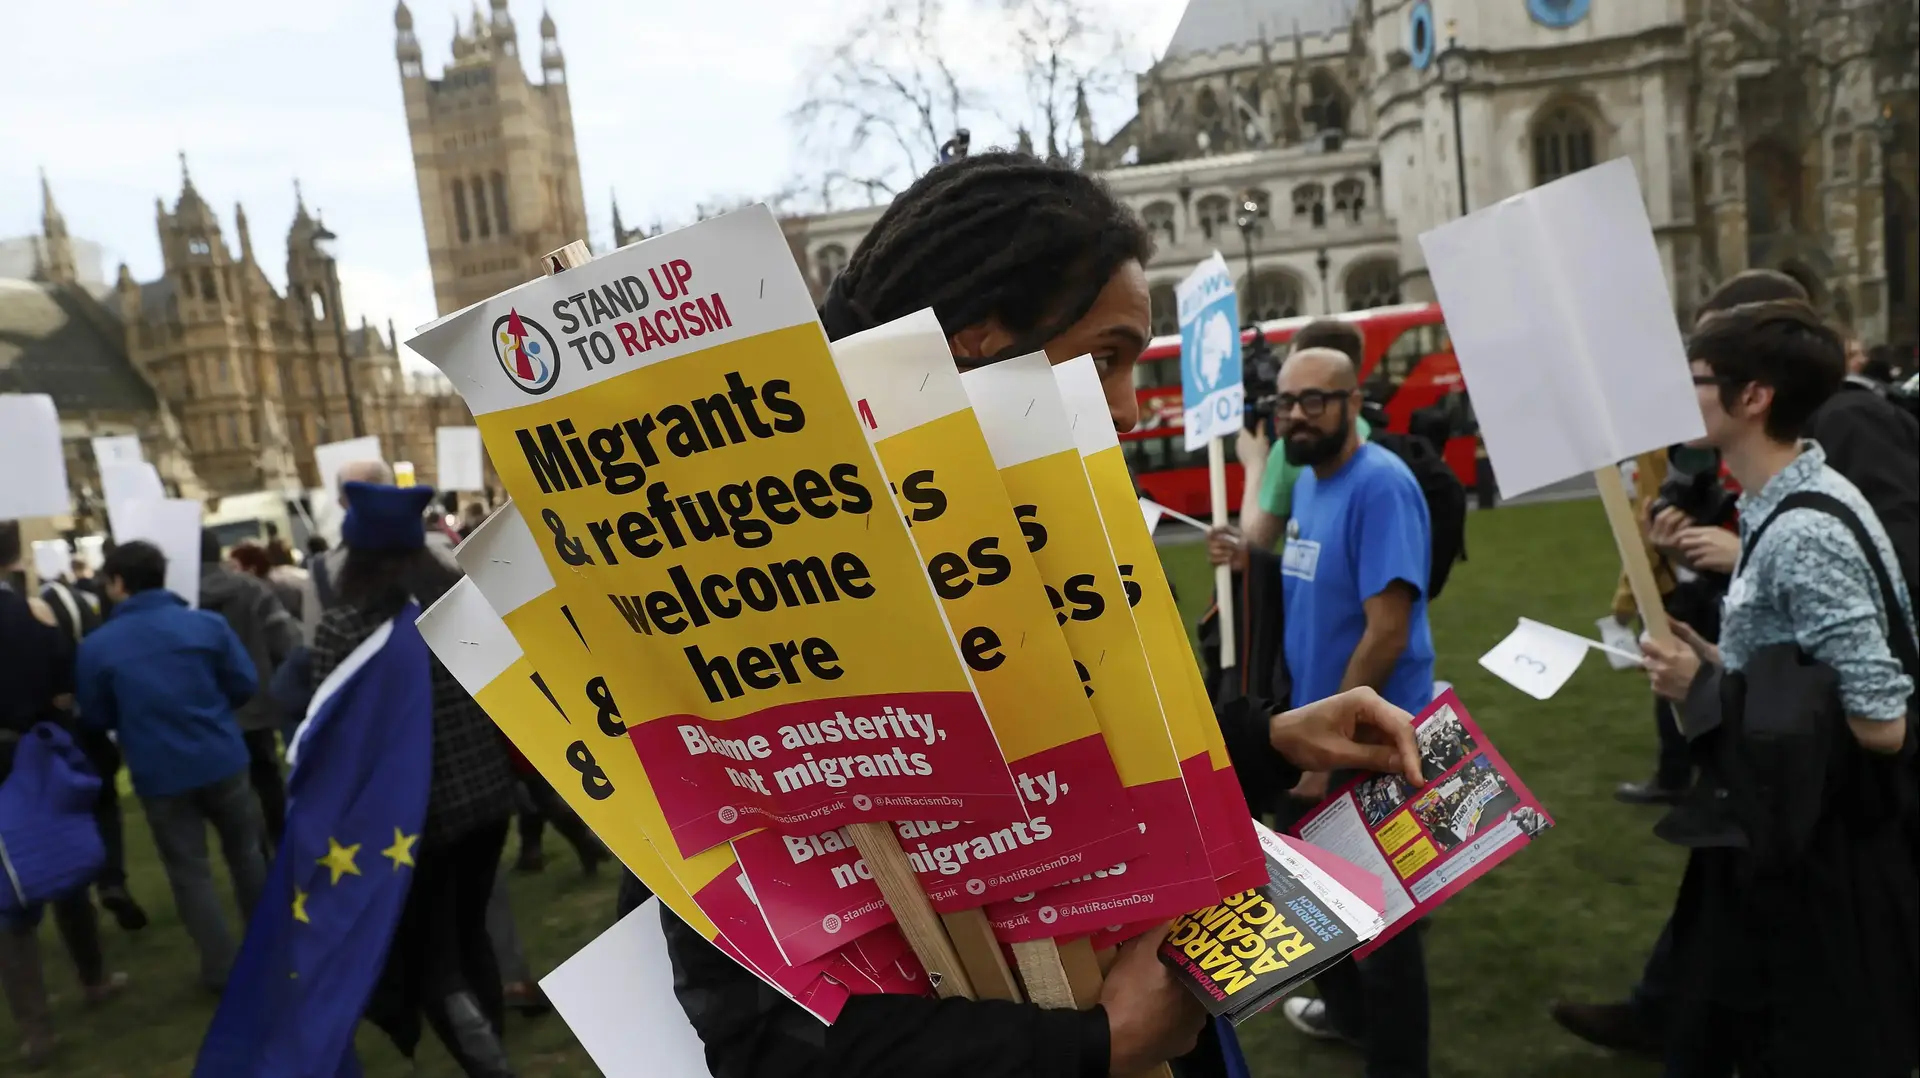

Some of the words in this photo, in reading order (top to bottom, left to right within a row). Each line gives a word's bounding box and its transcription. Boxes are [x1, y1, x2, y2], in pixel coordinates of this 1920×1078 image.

[553, 276, 649, 334] STAND
[648, 259, 692, 300] UP
[568, 331, 616, 371] TO
[614, 293, 732, 357] RACISM
[515, 371, 806, 495] Migrants
[541, 508, 596, 566] &
[586, 463, 873, 566] refugees
[607, 552, 876, 636] welcome
[683, 637, 845, 703] here
[678, 725, 772, 761] Blame
[777, 706, 947, 746] austerity,
[725, 767, 771, 796] not
[773, 747, 933, 788] migrants
[739, 800, 846, 824] stanacism.org.uk
[874, 796, 963, 808] @AntiRacismDay
[782, 828, 855, 865] Bla
[988, 852, 1082, 887] @AntiRacismDay
[831, 858, 875, 889] no
[1060, 893, 1154, 917] @AntiRacismDay
[1285, 899, 1333, 942] SATURDAY
[1298, 895, 1331, 926] MARCH
[1190, 904, 1288, 975] AGAIN
[1327, 924, 1343, 937] 18
[1168, 914, 1257, 995] MARCH
[1186, 962, 1227, 1001] NATIONAL
